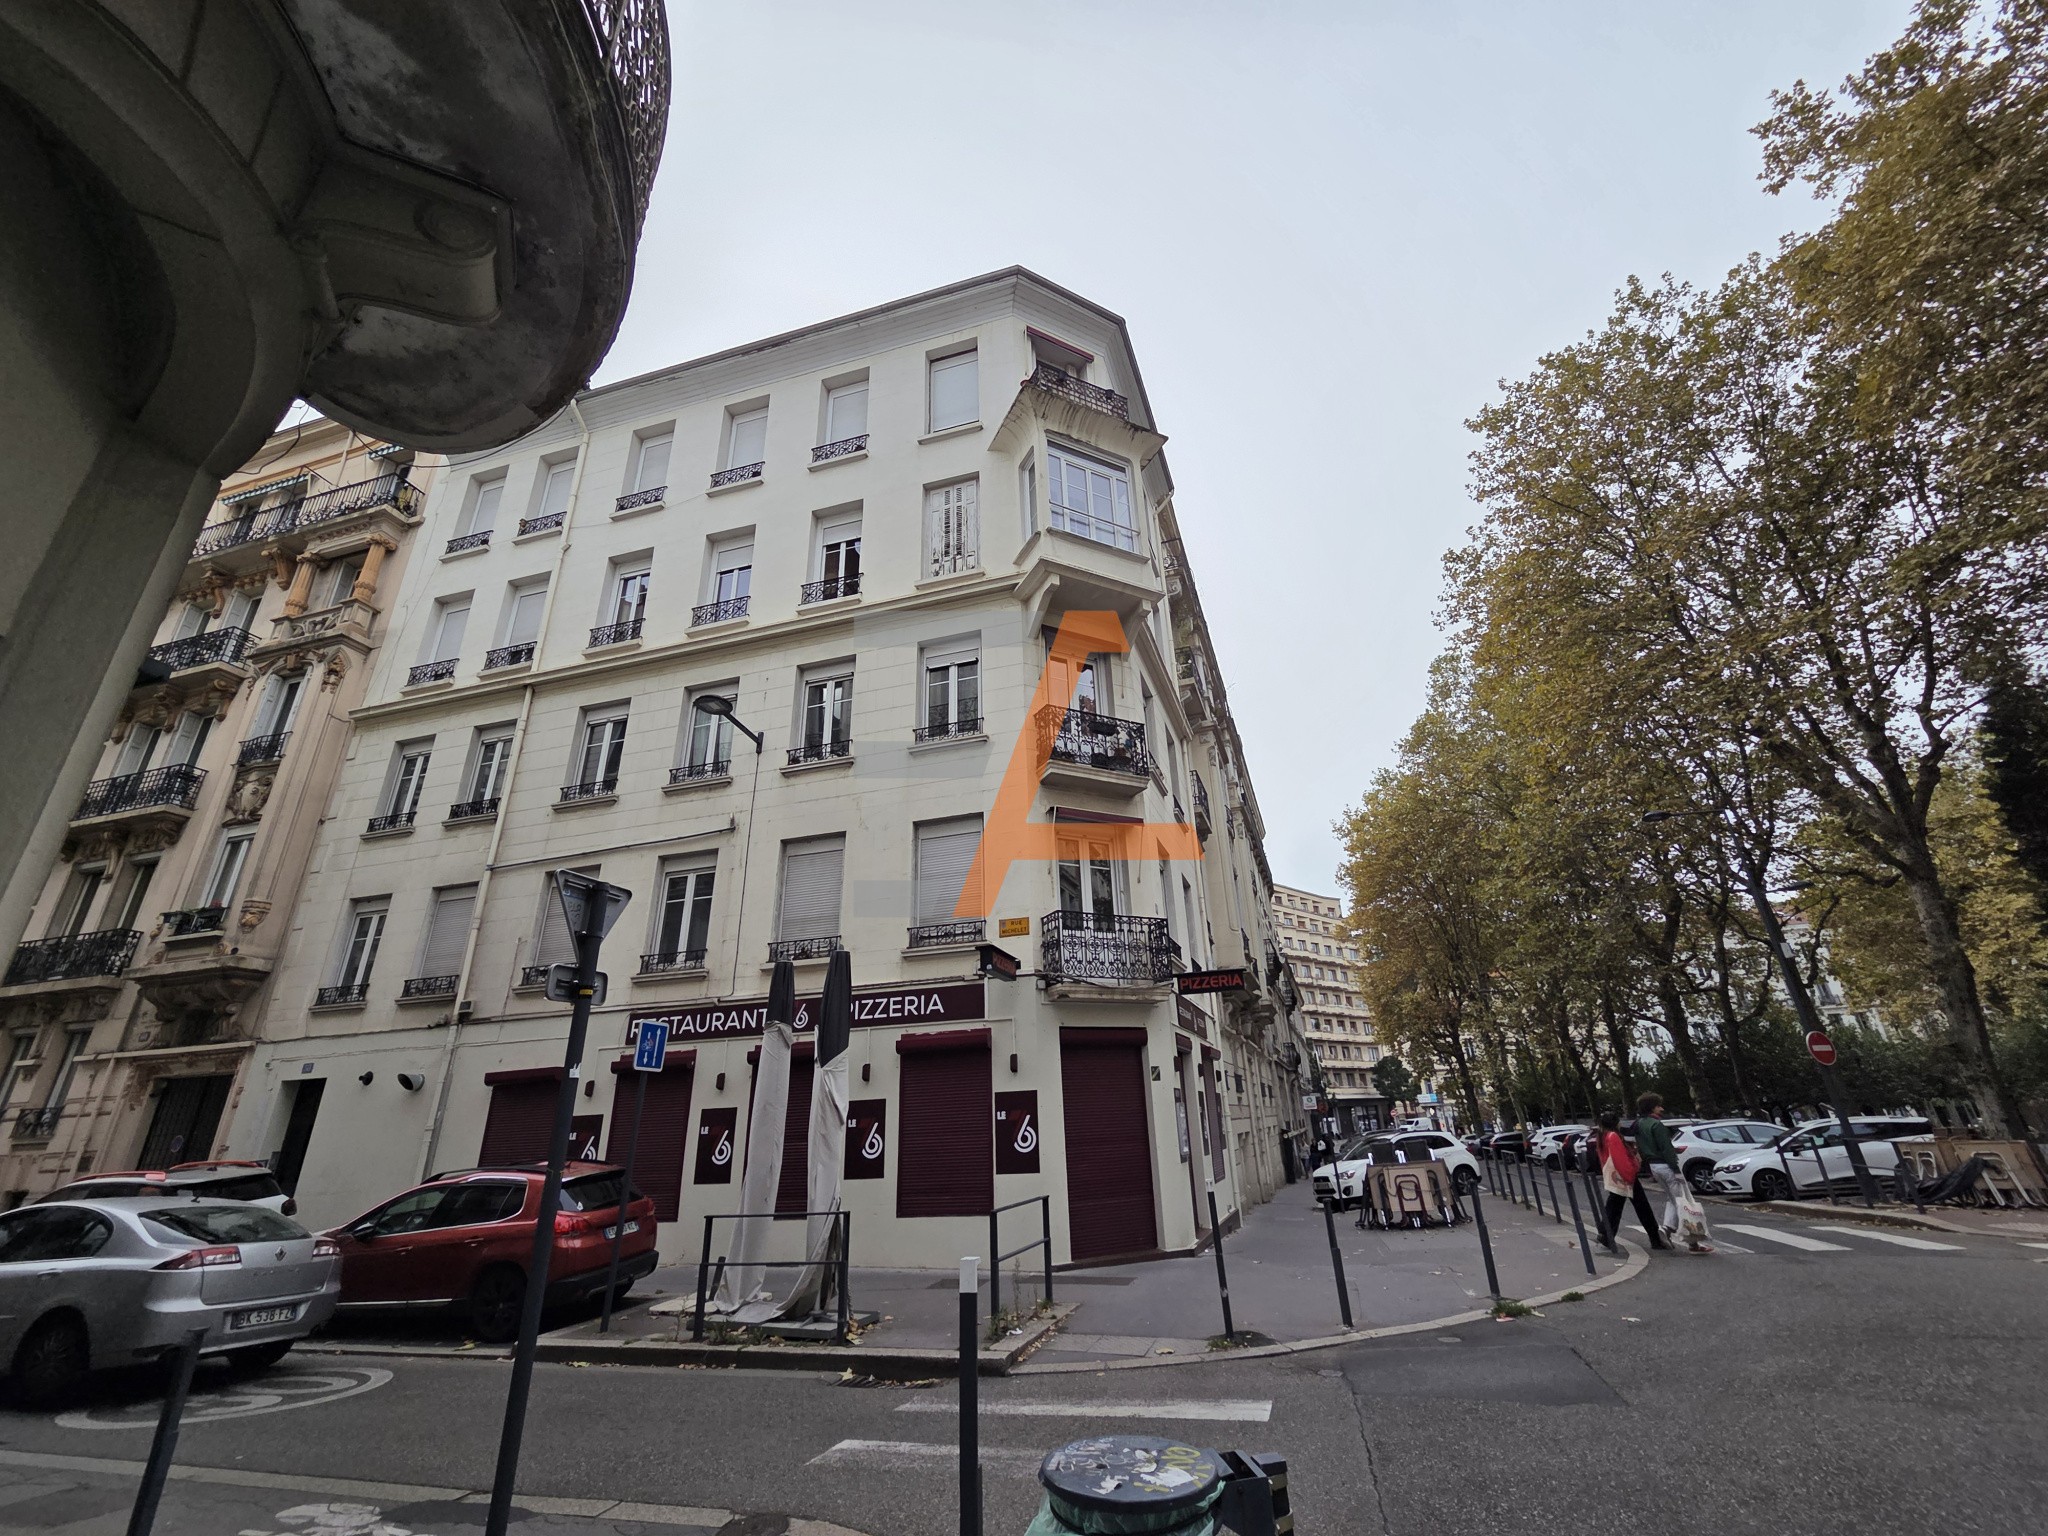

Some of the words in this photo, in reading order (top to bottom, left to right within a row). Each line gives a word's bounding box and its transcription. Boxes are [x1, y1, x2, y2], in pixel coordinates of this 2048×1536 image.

[1002, 926, 1027, 935] MICHELET
[1181, 974, 1243, 990] PIZZERIA
[630, 1008, 768, 1038] RTAURANT
[850, 993, 945, 1020] IZZERIA
[996, 1110, 1007, 1120] LE
[847, 1118, 857, 1128] LE
[700, 1126, 710, 1135] LE
